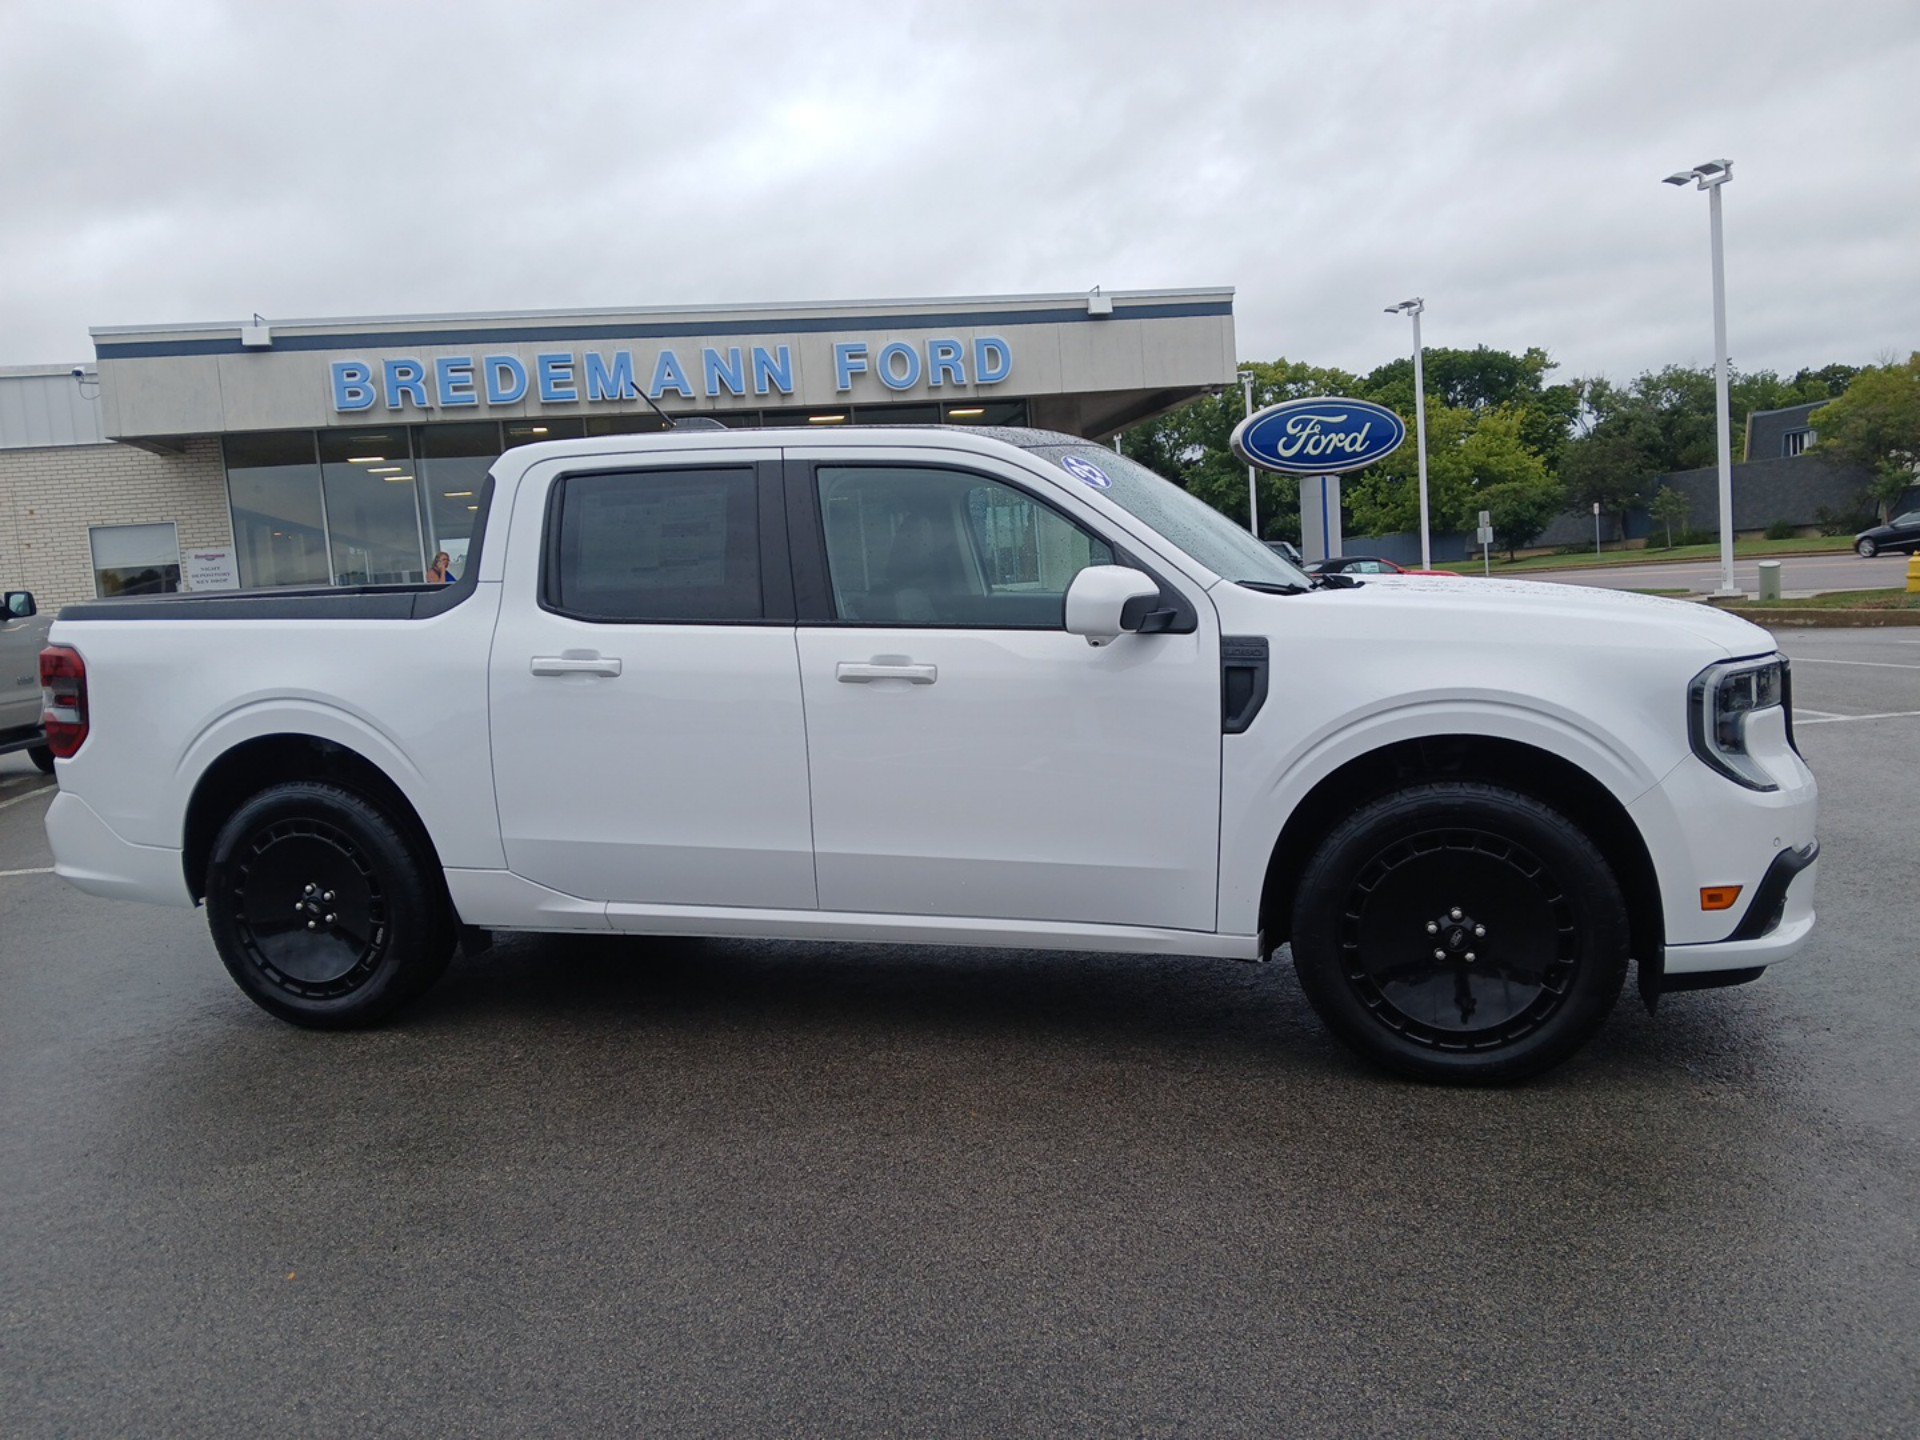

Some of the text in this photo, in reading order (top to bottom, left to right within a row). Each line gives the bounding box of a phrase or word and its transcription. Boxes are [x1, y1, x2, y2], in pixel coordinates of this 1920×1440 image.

[330, 336, 1012, 412] BREDEMANN FORD
[1277, 414, 1372, 458] Ford
